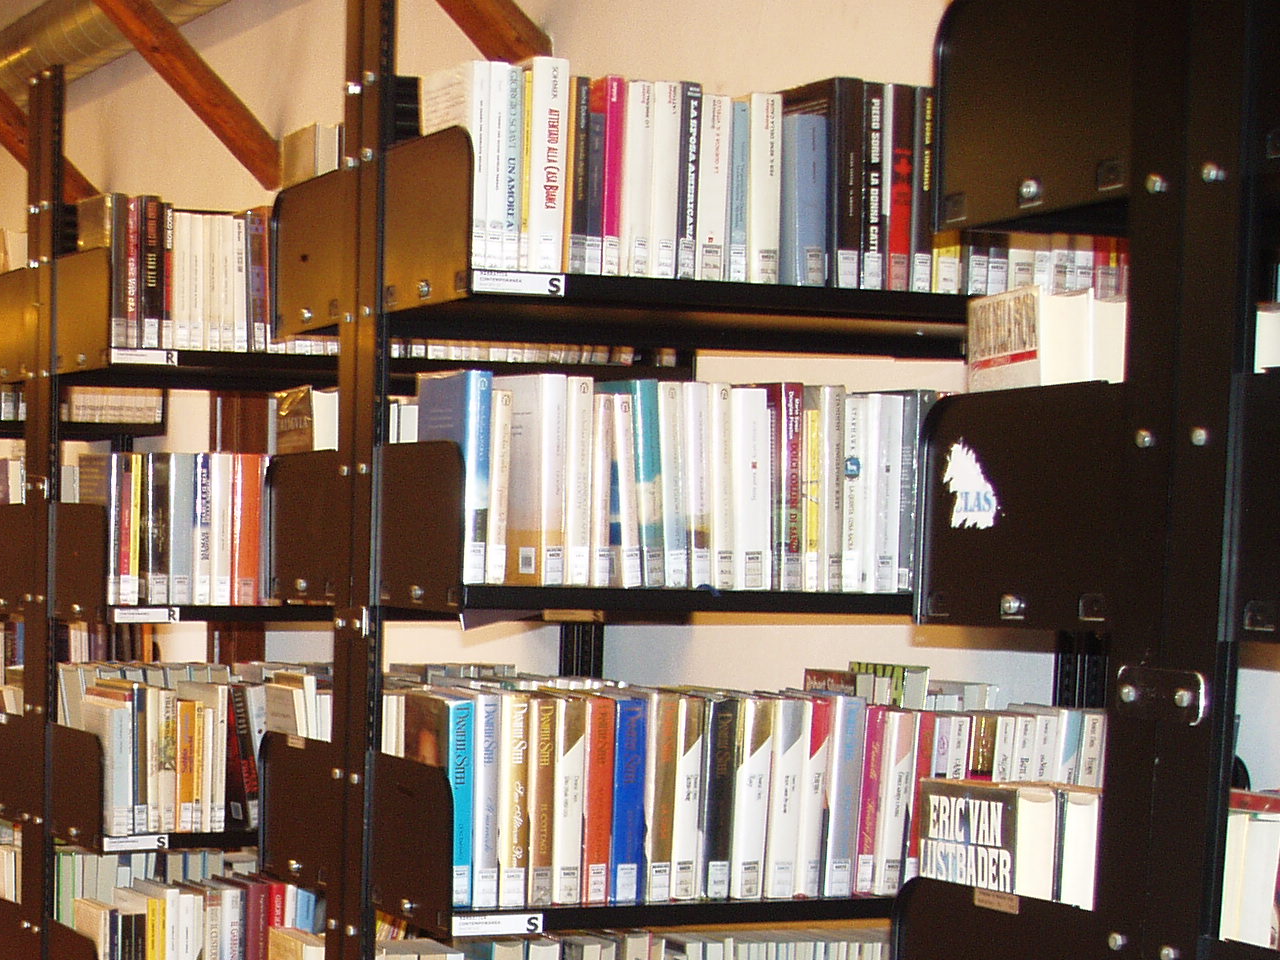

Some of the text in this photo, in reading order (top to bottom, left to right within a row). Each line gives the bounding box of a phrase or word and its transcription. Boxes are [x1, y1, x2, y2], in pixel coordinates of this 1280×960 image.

[547, 108, 559, 144] ATTENTATO
[870, 98, 880, 130] PIERO
[546, 146, 558, 163] ALLA
[688, 120, 696, 162] SPOSA
[506, 176, 516, 216] AMORE
[548, 278, 560, 294] S
[166, 350, 174, 364] R
[790, 442, 799, 470] DOLCI
[168, 608, 176, 621] R
[928, 794, 966, 844] ERIC
[968, 797, 1003, 847] VAN
[156, 836, 166, 848] S
[920, 837, 1012, 894] LUSTBADER
[526, 916, 538, 934] S
